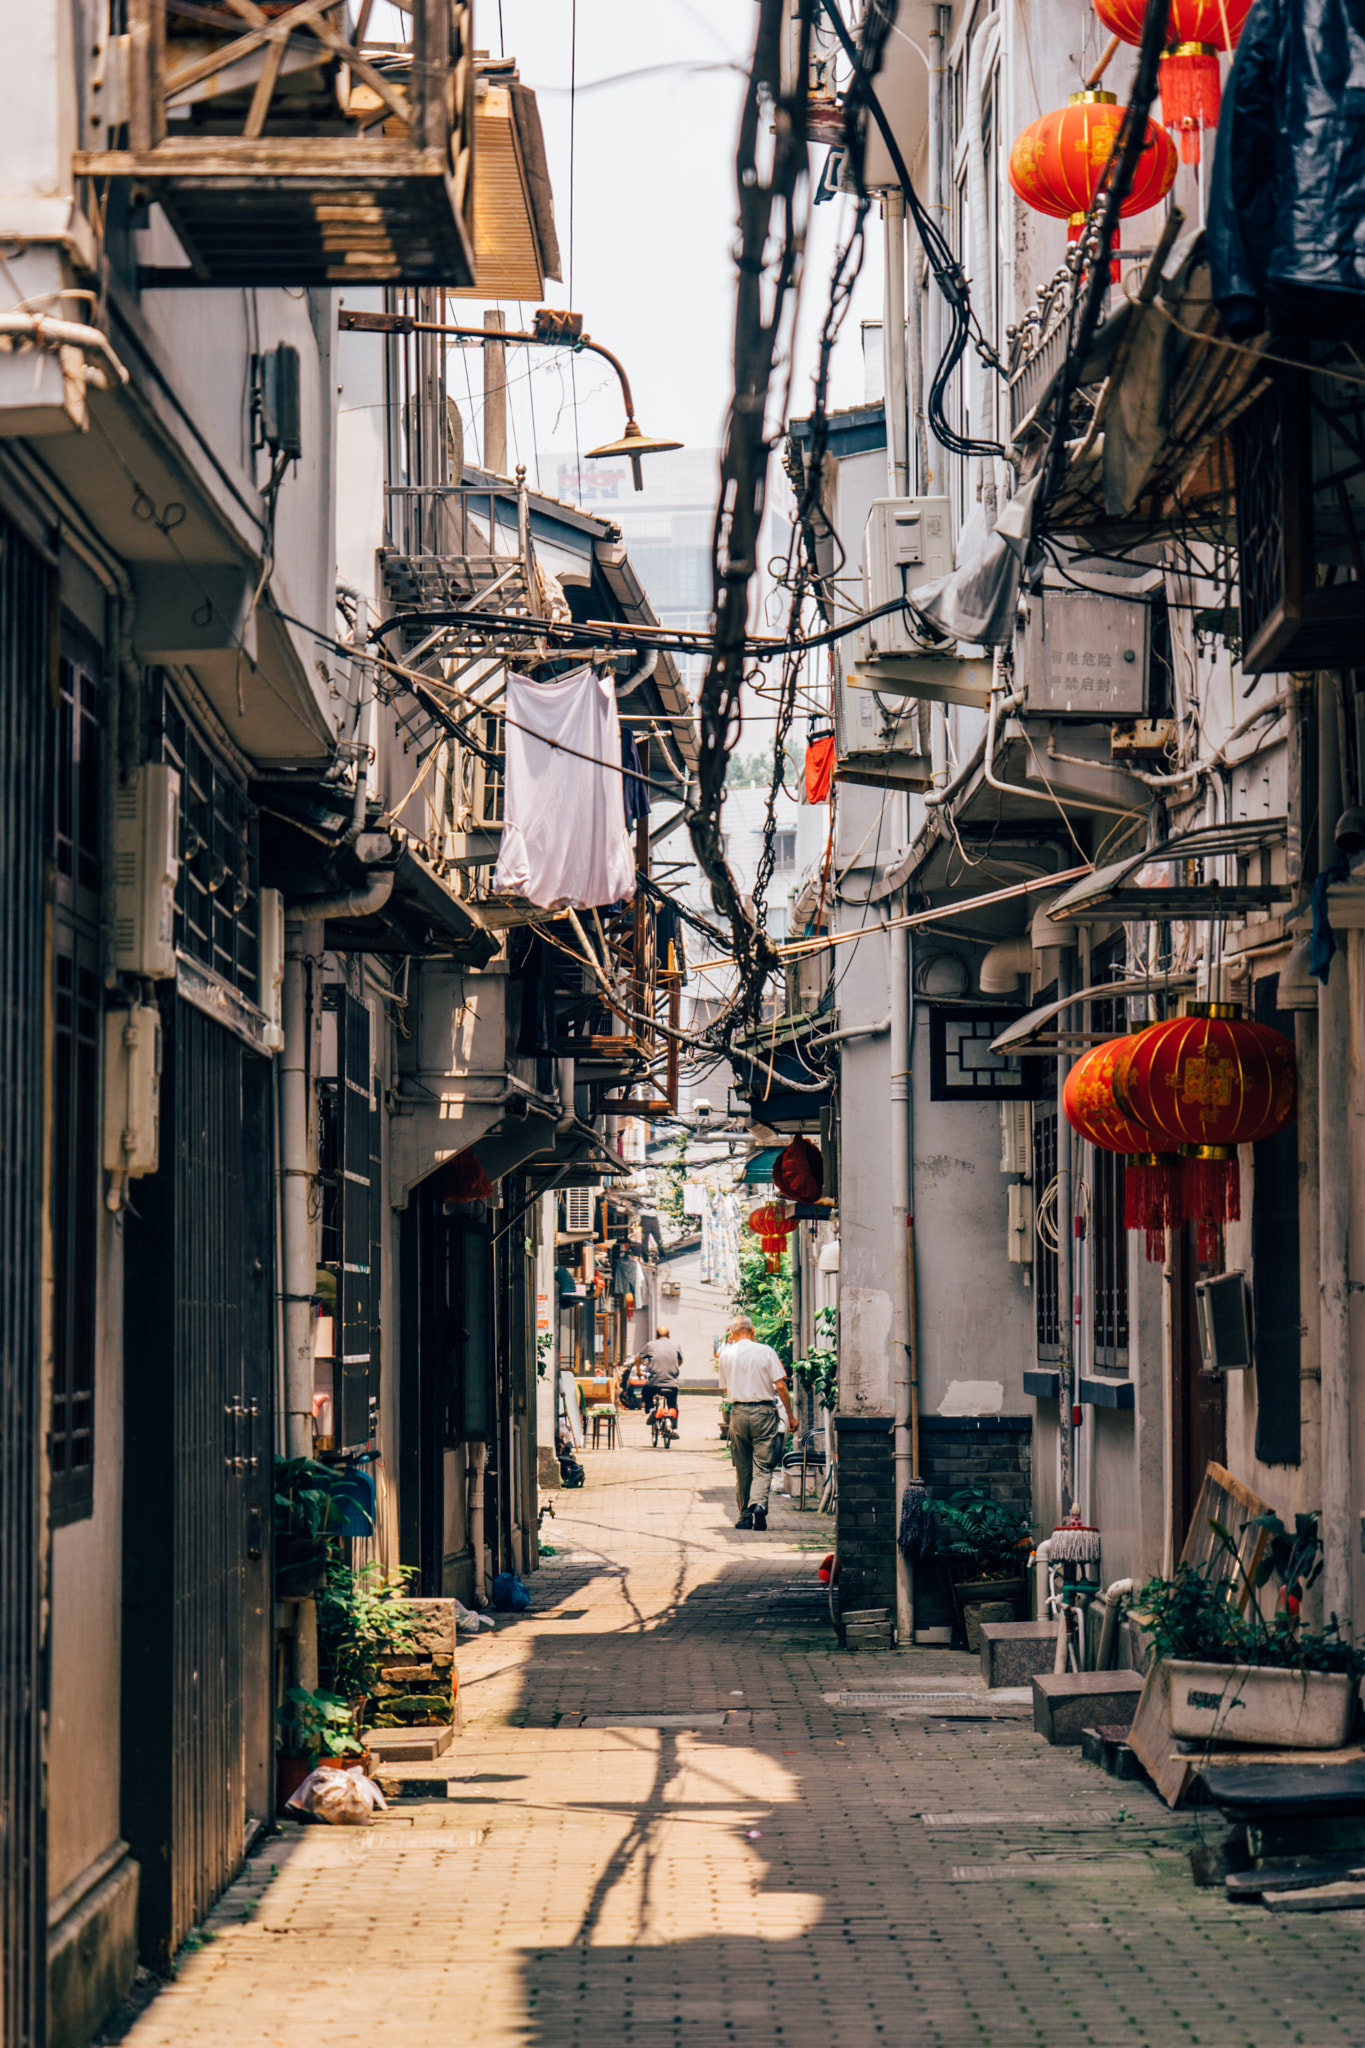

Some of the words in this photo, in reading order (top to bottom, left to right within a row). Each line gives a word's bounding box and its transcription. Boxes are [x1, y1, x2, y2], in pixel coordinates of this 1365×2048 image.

[1050, 651, 1112, 667] 有电危险
[1050, 676, 1111, 692] 严禁启封
